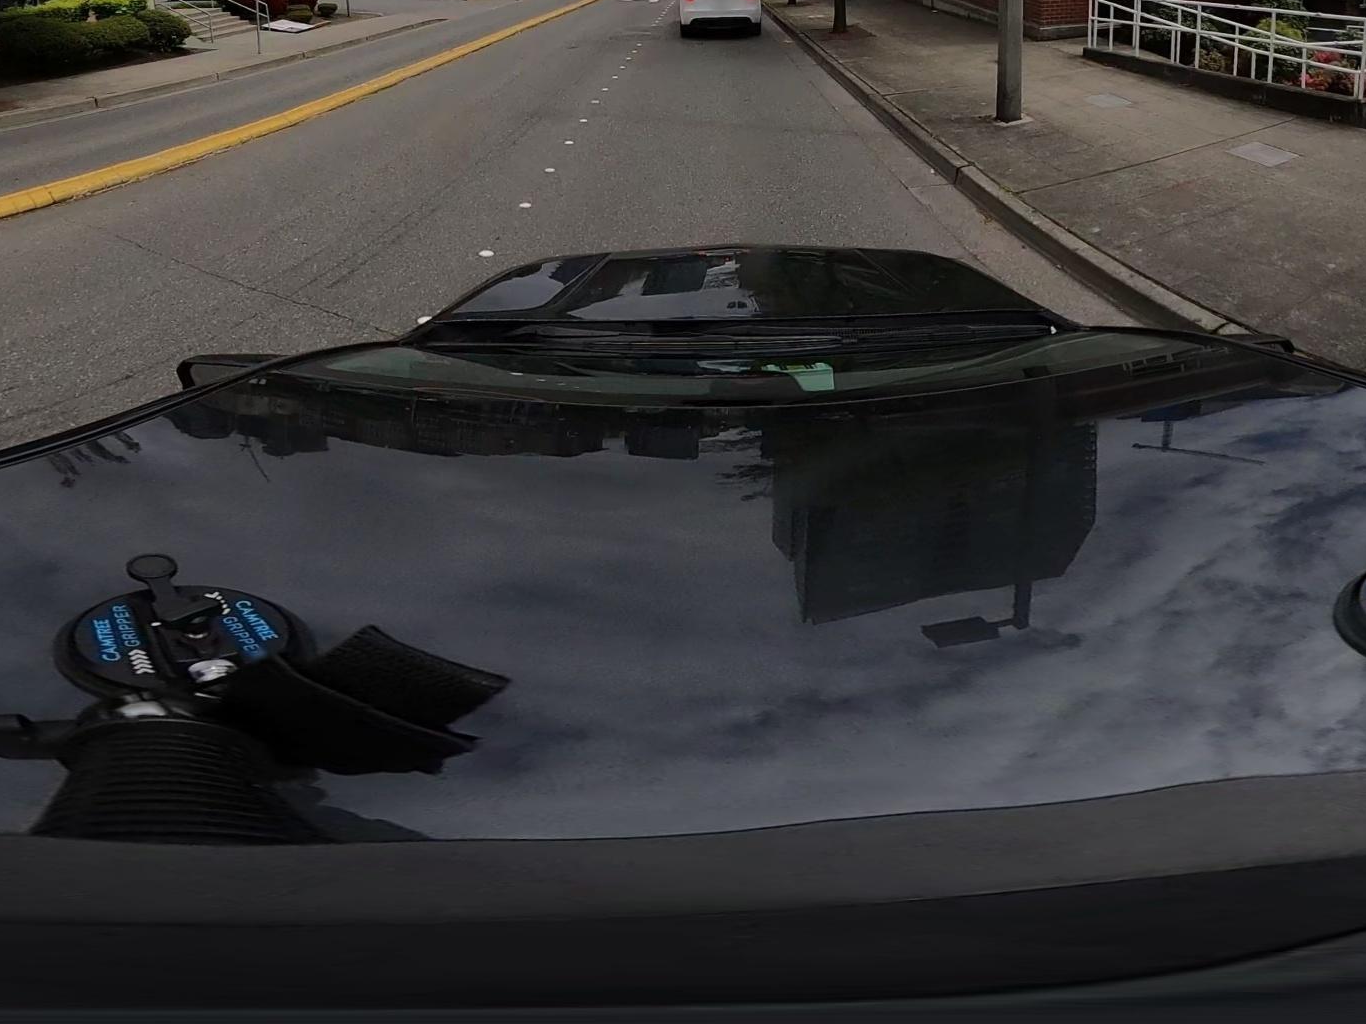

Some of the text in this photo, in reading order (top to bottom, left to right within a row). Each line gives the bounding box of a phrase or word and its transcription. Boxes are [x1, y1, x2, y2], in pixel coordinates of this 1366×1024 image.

[93, 618, 122, 661] CAMTREE
[112, 604, 141, 647] GRIPPER
[235, 600, 279, 641] CAMTREE
